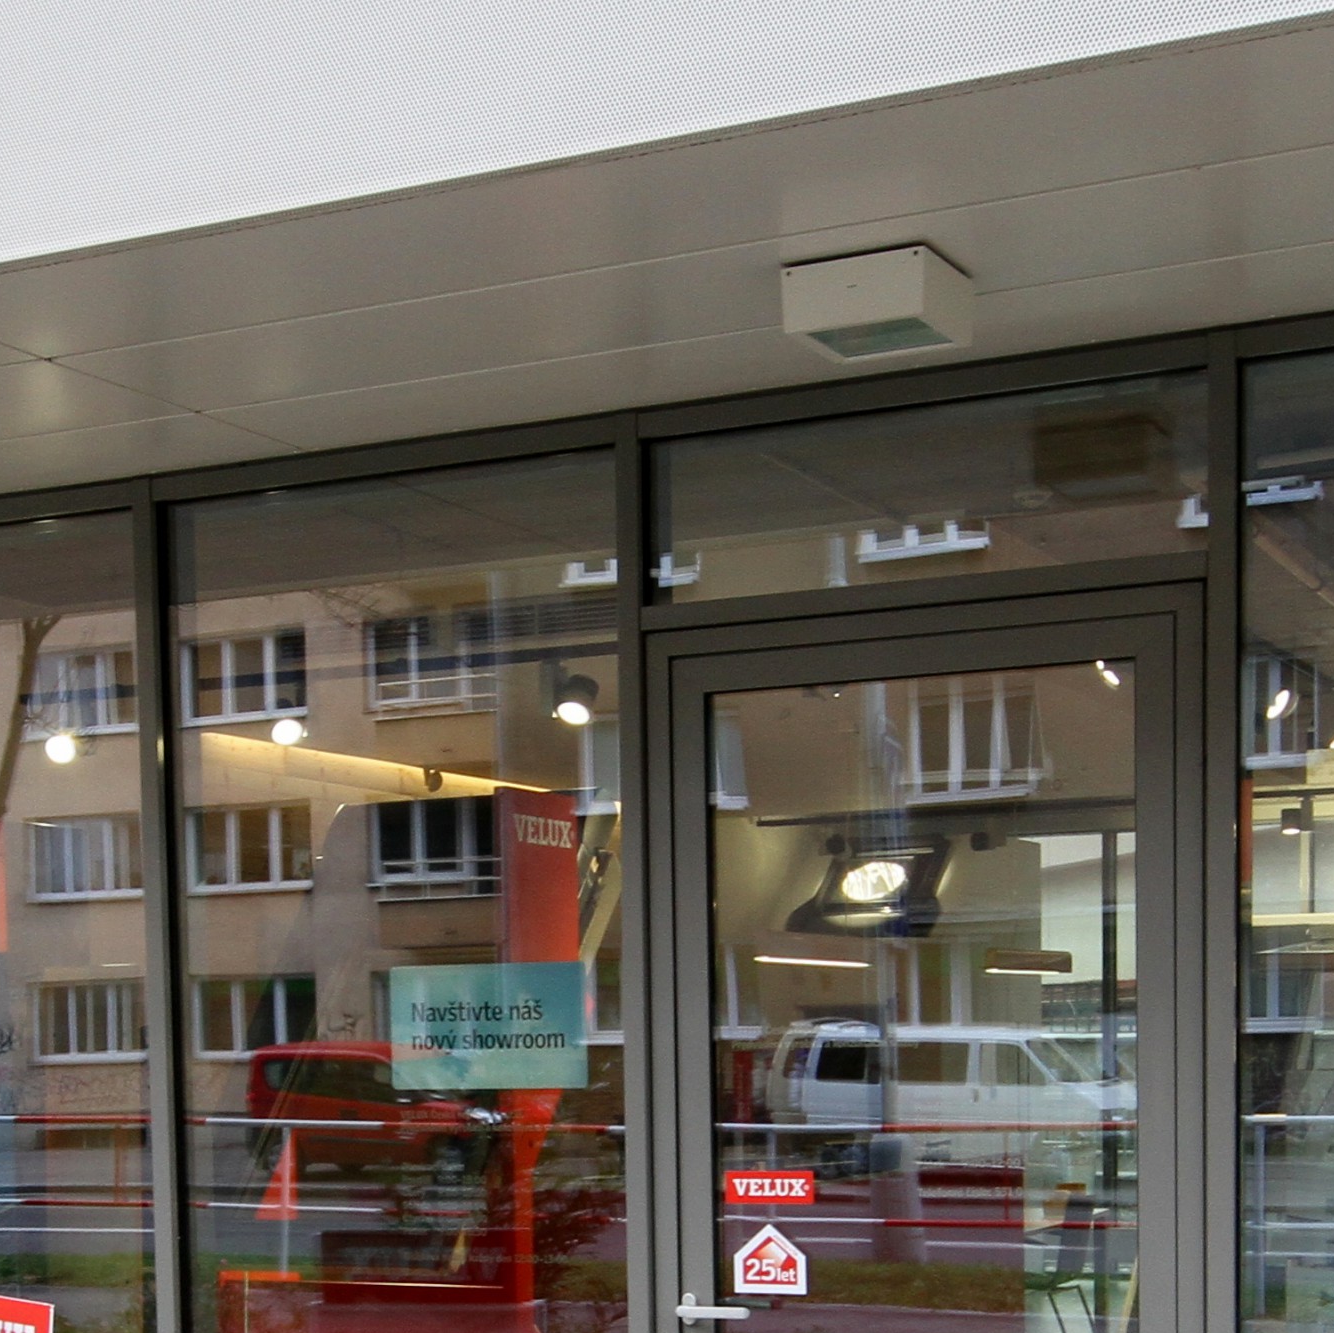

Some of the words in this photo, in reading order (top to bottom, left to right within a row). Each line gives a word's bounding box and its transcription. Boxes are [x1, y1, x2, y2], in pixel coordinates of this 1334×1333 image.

[513, 813, 573, 849] VELUX
[411, 1000, 503, 1023] Navštivte
[509, 999, 544, 1022] náš
[411, 1029, 458, 1050] nový
[462, 1028, 565, 1050] showroom
[732, 1178, 808, 1197] VELUX
